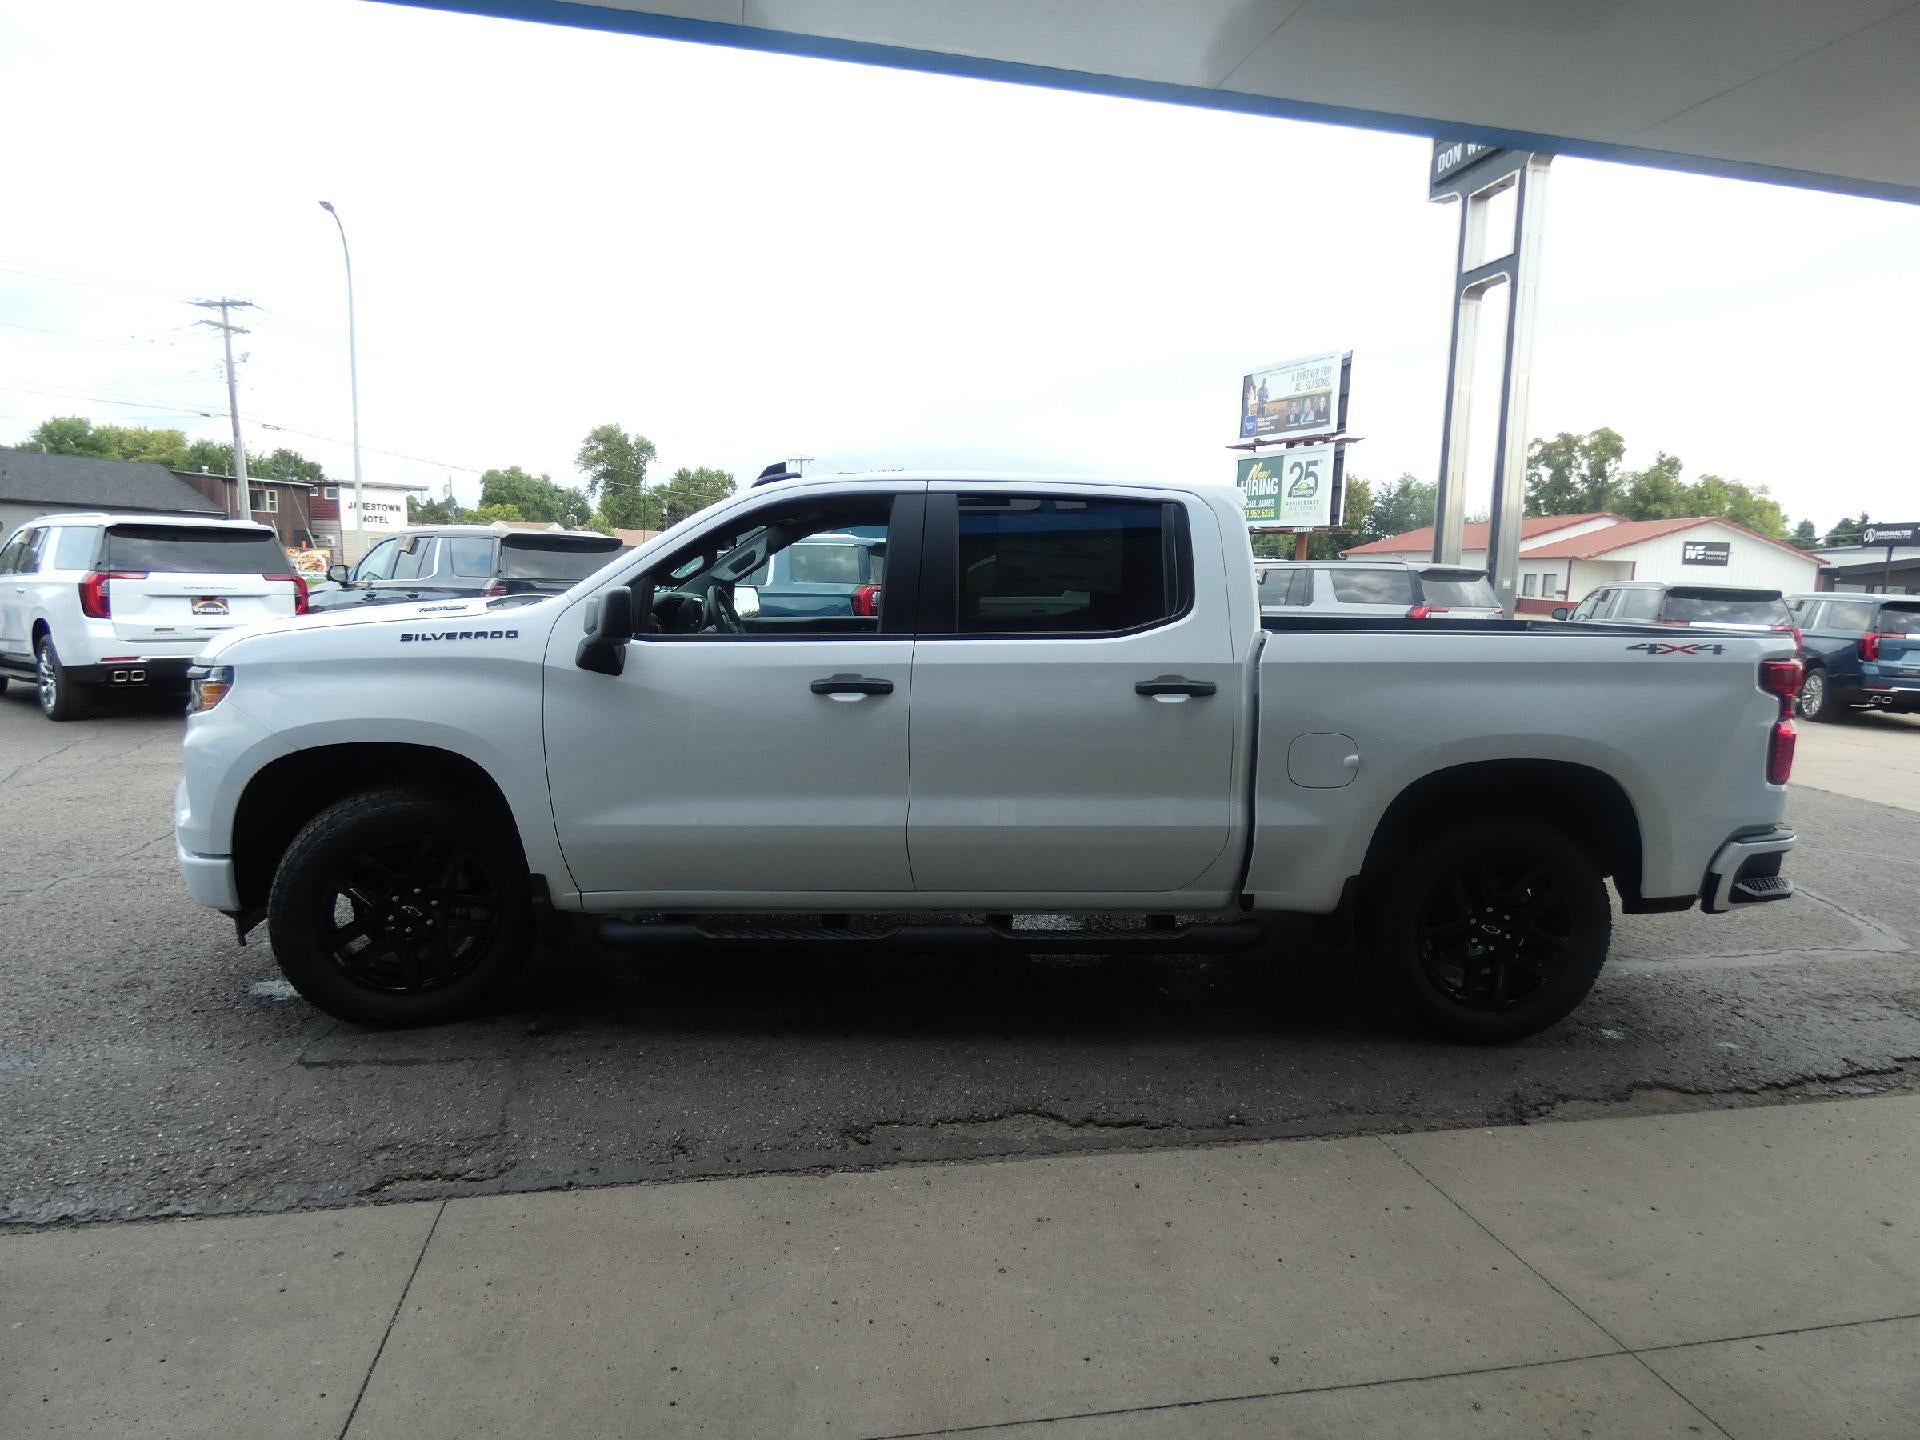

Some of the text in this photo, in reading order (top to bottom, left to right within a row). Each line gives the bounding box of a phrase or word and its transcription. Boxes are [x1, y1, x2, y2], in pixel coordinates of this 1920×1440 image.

[1438, 143, 1462, 174] DON
[1241, 478, 1279, 496] HIRING
[1287, 460, 1319, 498] 25
[400, 630, 518, 641] SILVERADO
